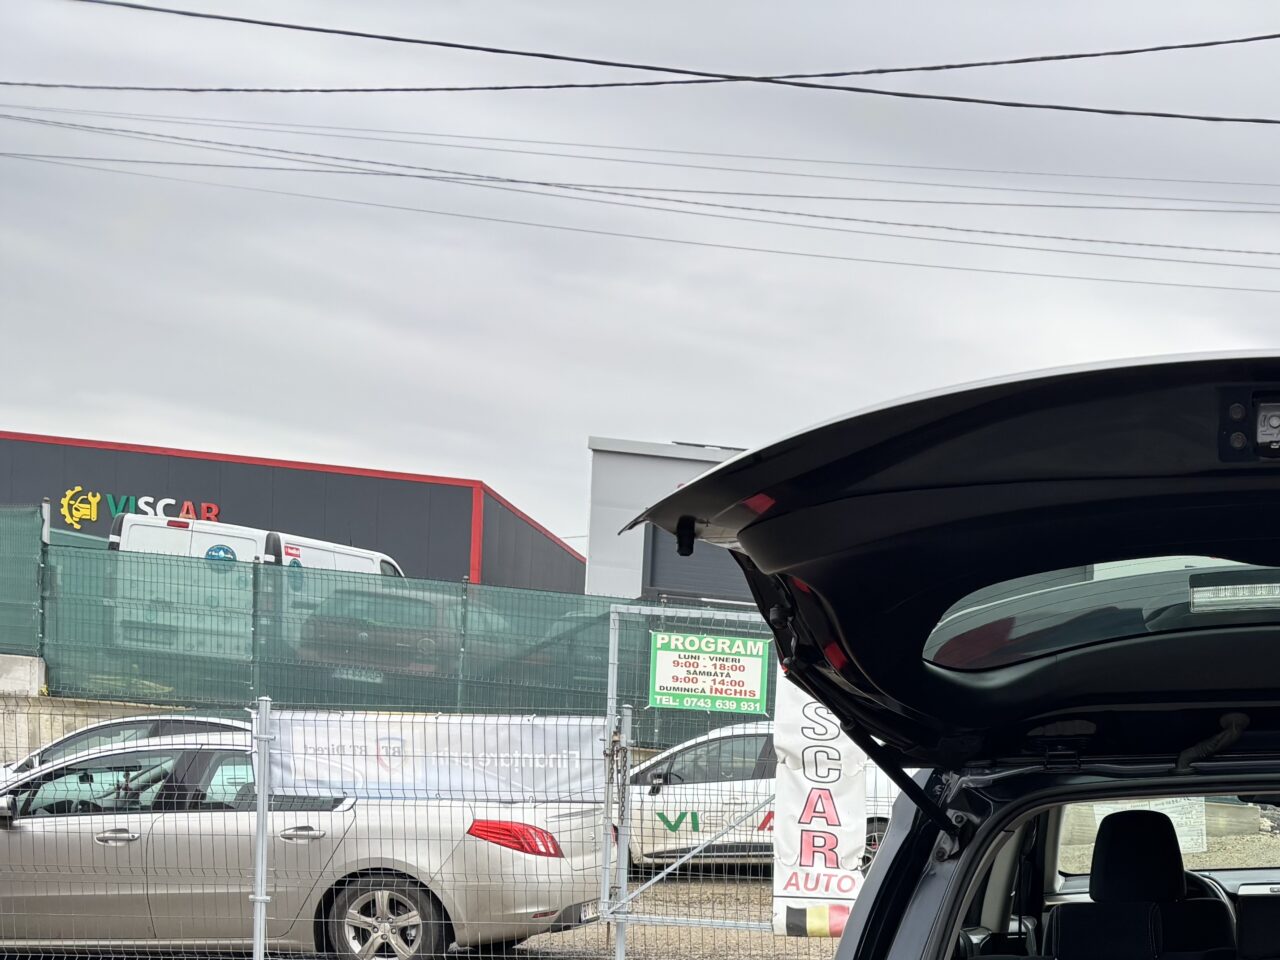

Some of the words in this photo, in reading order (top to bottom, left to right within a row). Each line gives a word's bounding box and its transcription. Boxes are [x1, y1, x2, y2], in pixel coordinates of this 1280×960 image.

[106, 494, 220, 521] VISCAR
[656, 634, 764, 656] PROGRAM
[672, 660, 699, 669] 9:00
[711, 663, 746, 672] 18:00
[708, 655, 741, 664] VINERI
[672, 675, 699, 684] 9:00
[711, 678, 745, 688] 14:00
[655, 695, 679, 705] TEL:
[683, 697, 711, 708] 0743
[715, 700, 737, 710] 639
[740, 702, 760, 711] 931
[783, 871, 856, 894] AUTO
